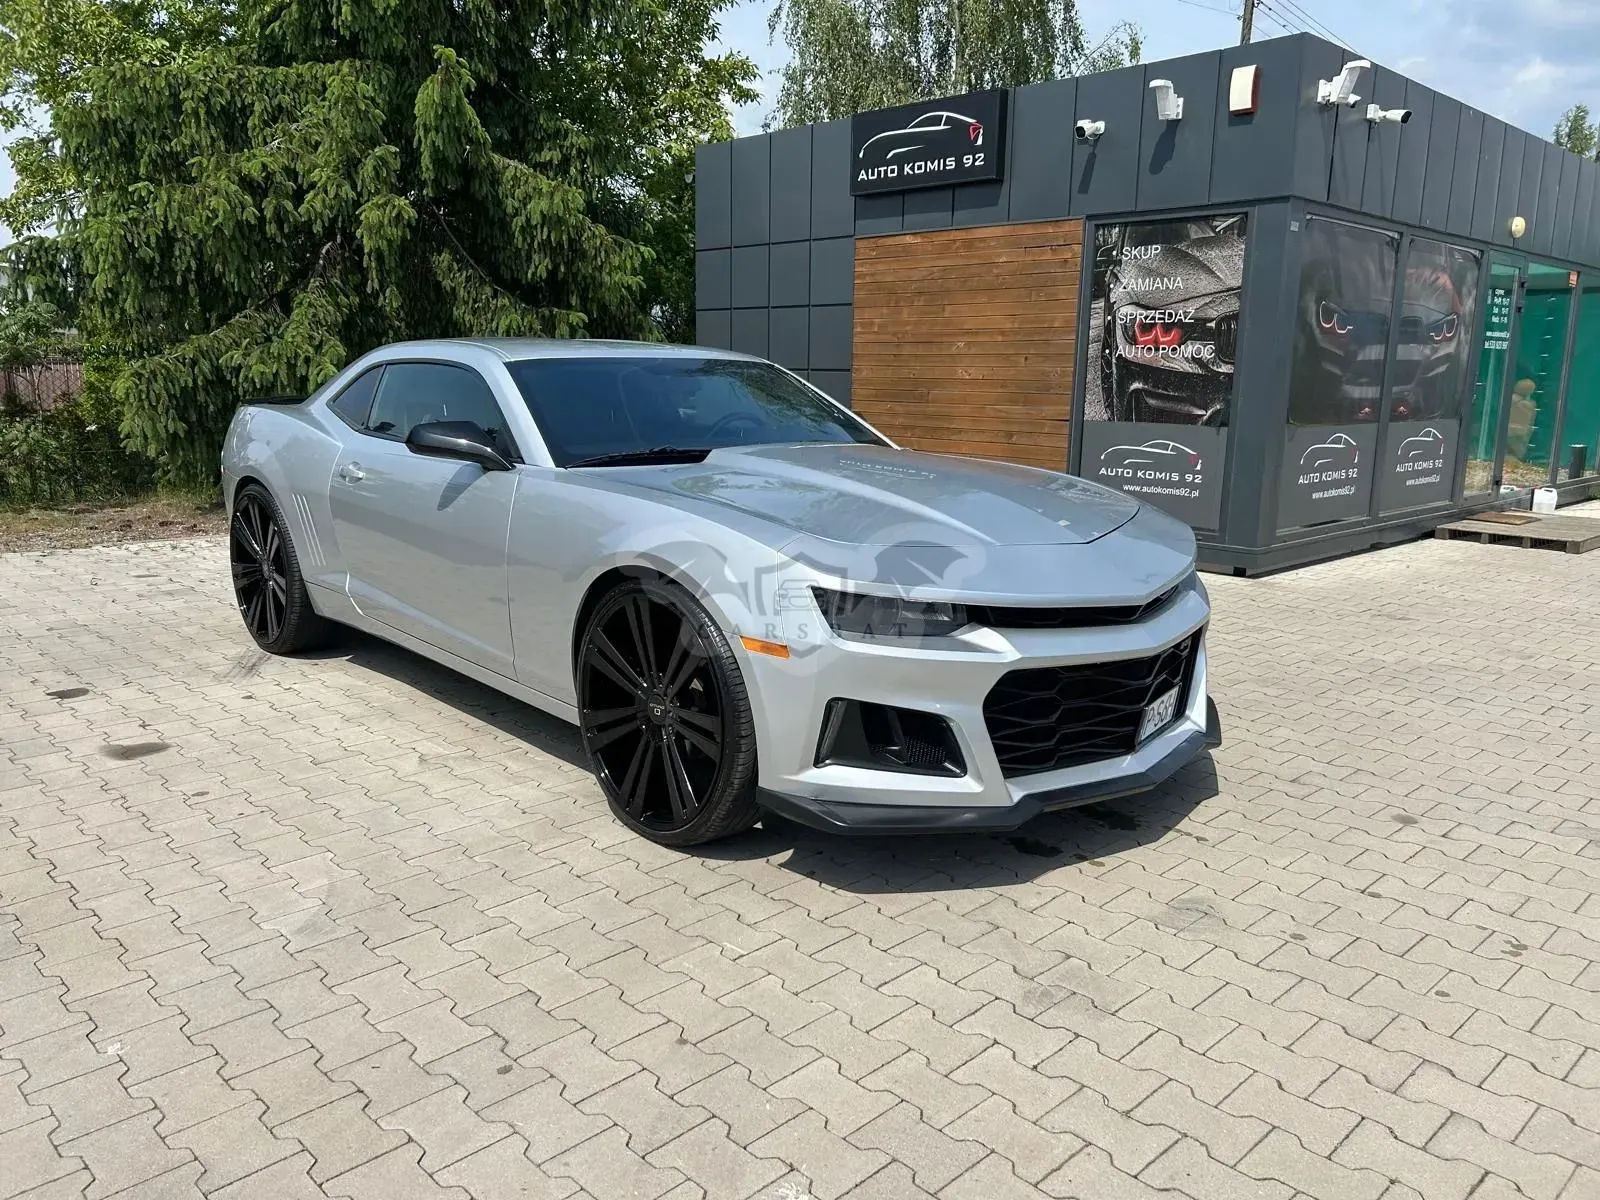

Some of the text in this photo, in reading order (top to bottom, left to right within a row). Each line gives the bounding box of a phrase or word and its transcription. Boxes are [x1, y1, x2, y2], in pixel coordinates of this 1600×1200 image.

[857, 153, 985, 181] AUTO KOMIS 92
[1121, 245, 1161, 260] SKUP
[1119, 276, 1184, 292] ZAMIANA
[1117, 307, 1195, 324] SPRZEDAŻ
[1115, 344, 1216, 358] AUTO POMOC
[1395, 459, 1443, 473] AUTO KOMIS 92
[1098, 467, 1203, 483] AUTO KOMIS 92
[1297, 468, 1358, 485] AUTO KOMIS 92
[1122, 484, 1200, 498] www.autokomis92.pl
